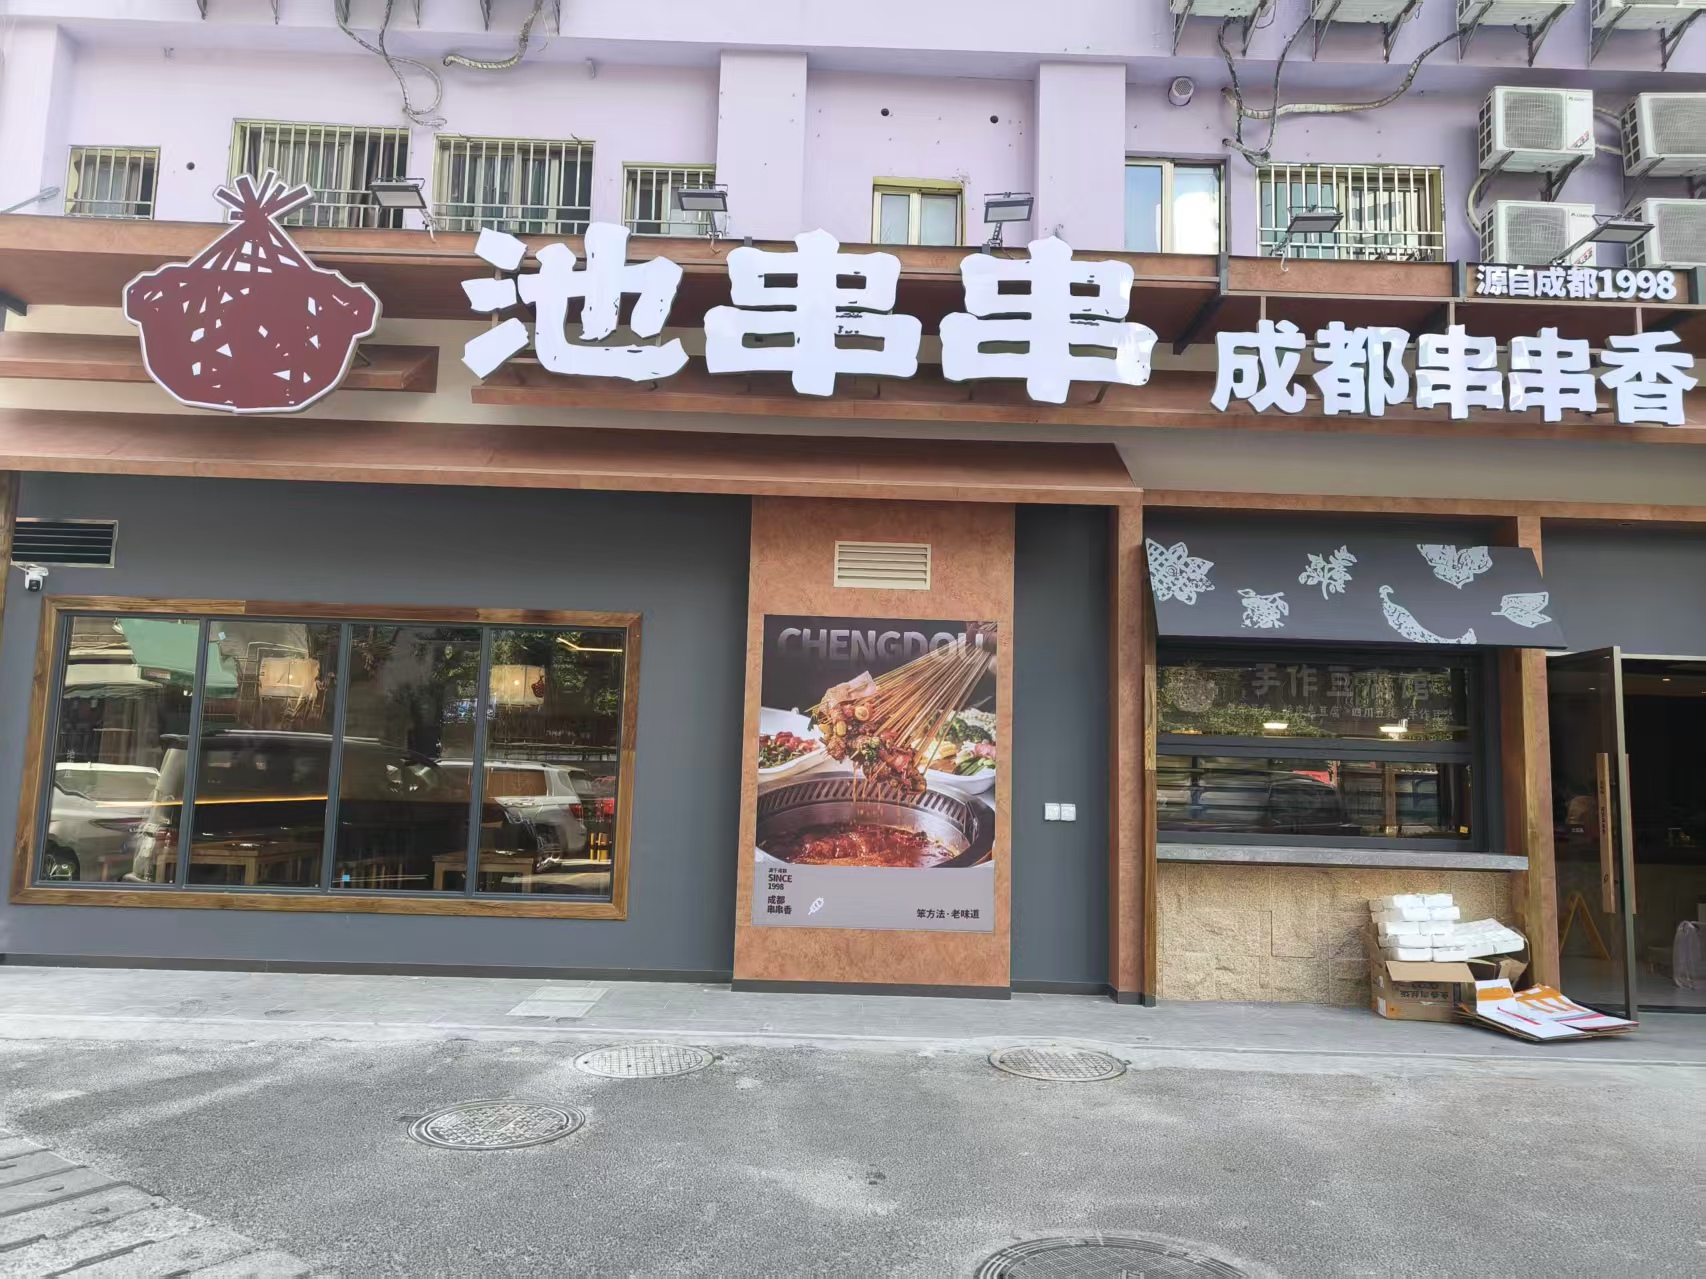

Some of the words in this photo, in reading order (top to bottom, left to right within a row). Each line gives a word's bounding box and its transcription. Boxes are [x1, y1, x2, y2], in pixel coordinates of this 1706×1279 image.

[1476, 265, 1678, 301] 源自成都1998
[461, 222, 1158, 404] 池串串
[1211, 319, 1699, 426] 成都串串香
[777, 627, 985, 664] CHENGDOU
[768, 874, 792, 882] SINCE
[768, 895, 785, 904] 成都
[768, 905, 791, 914] 串串香
[916, 908, 980, 919] 笨方法·老味道
